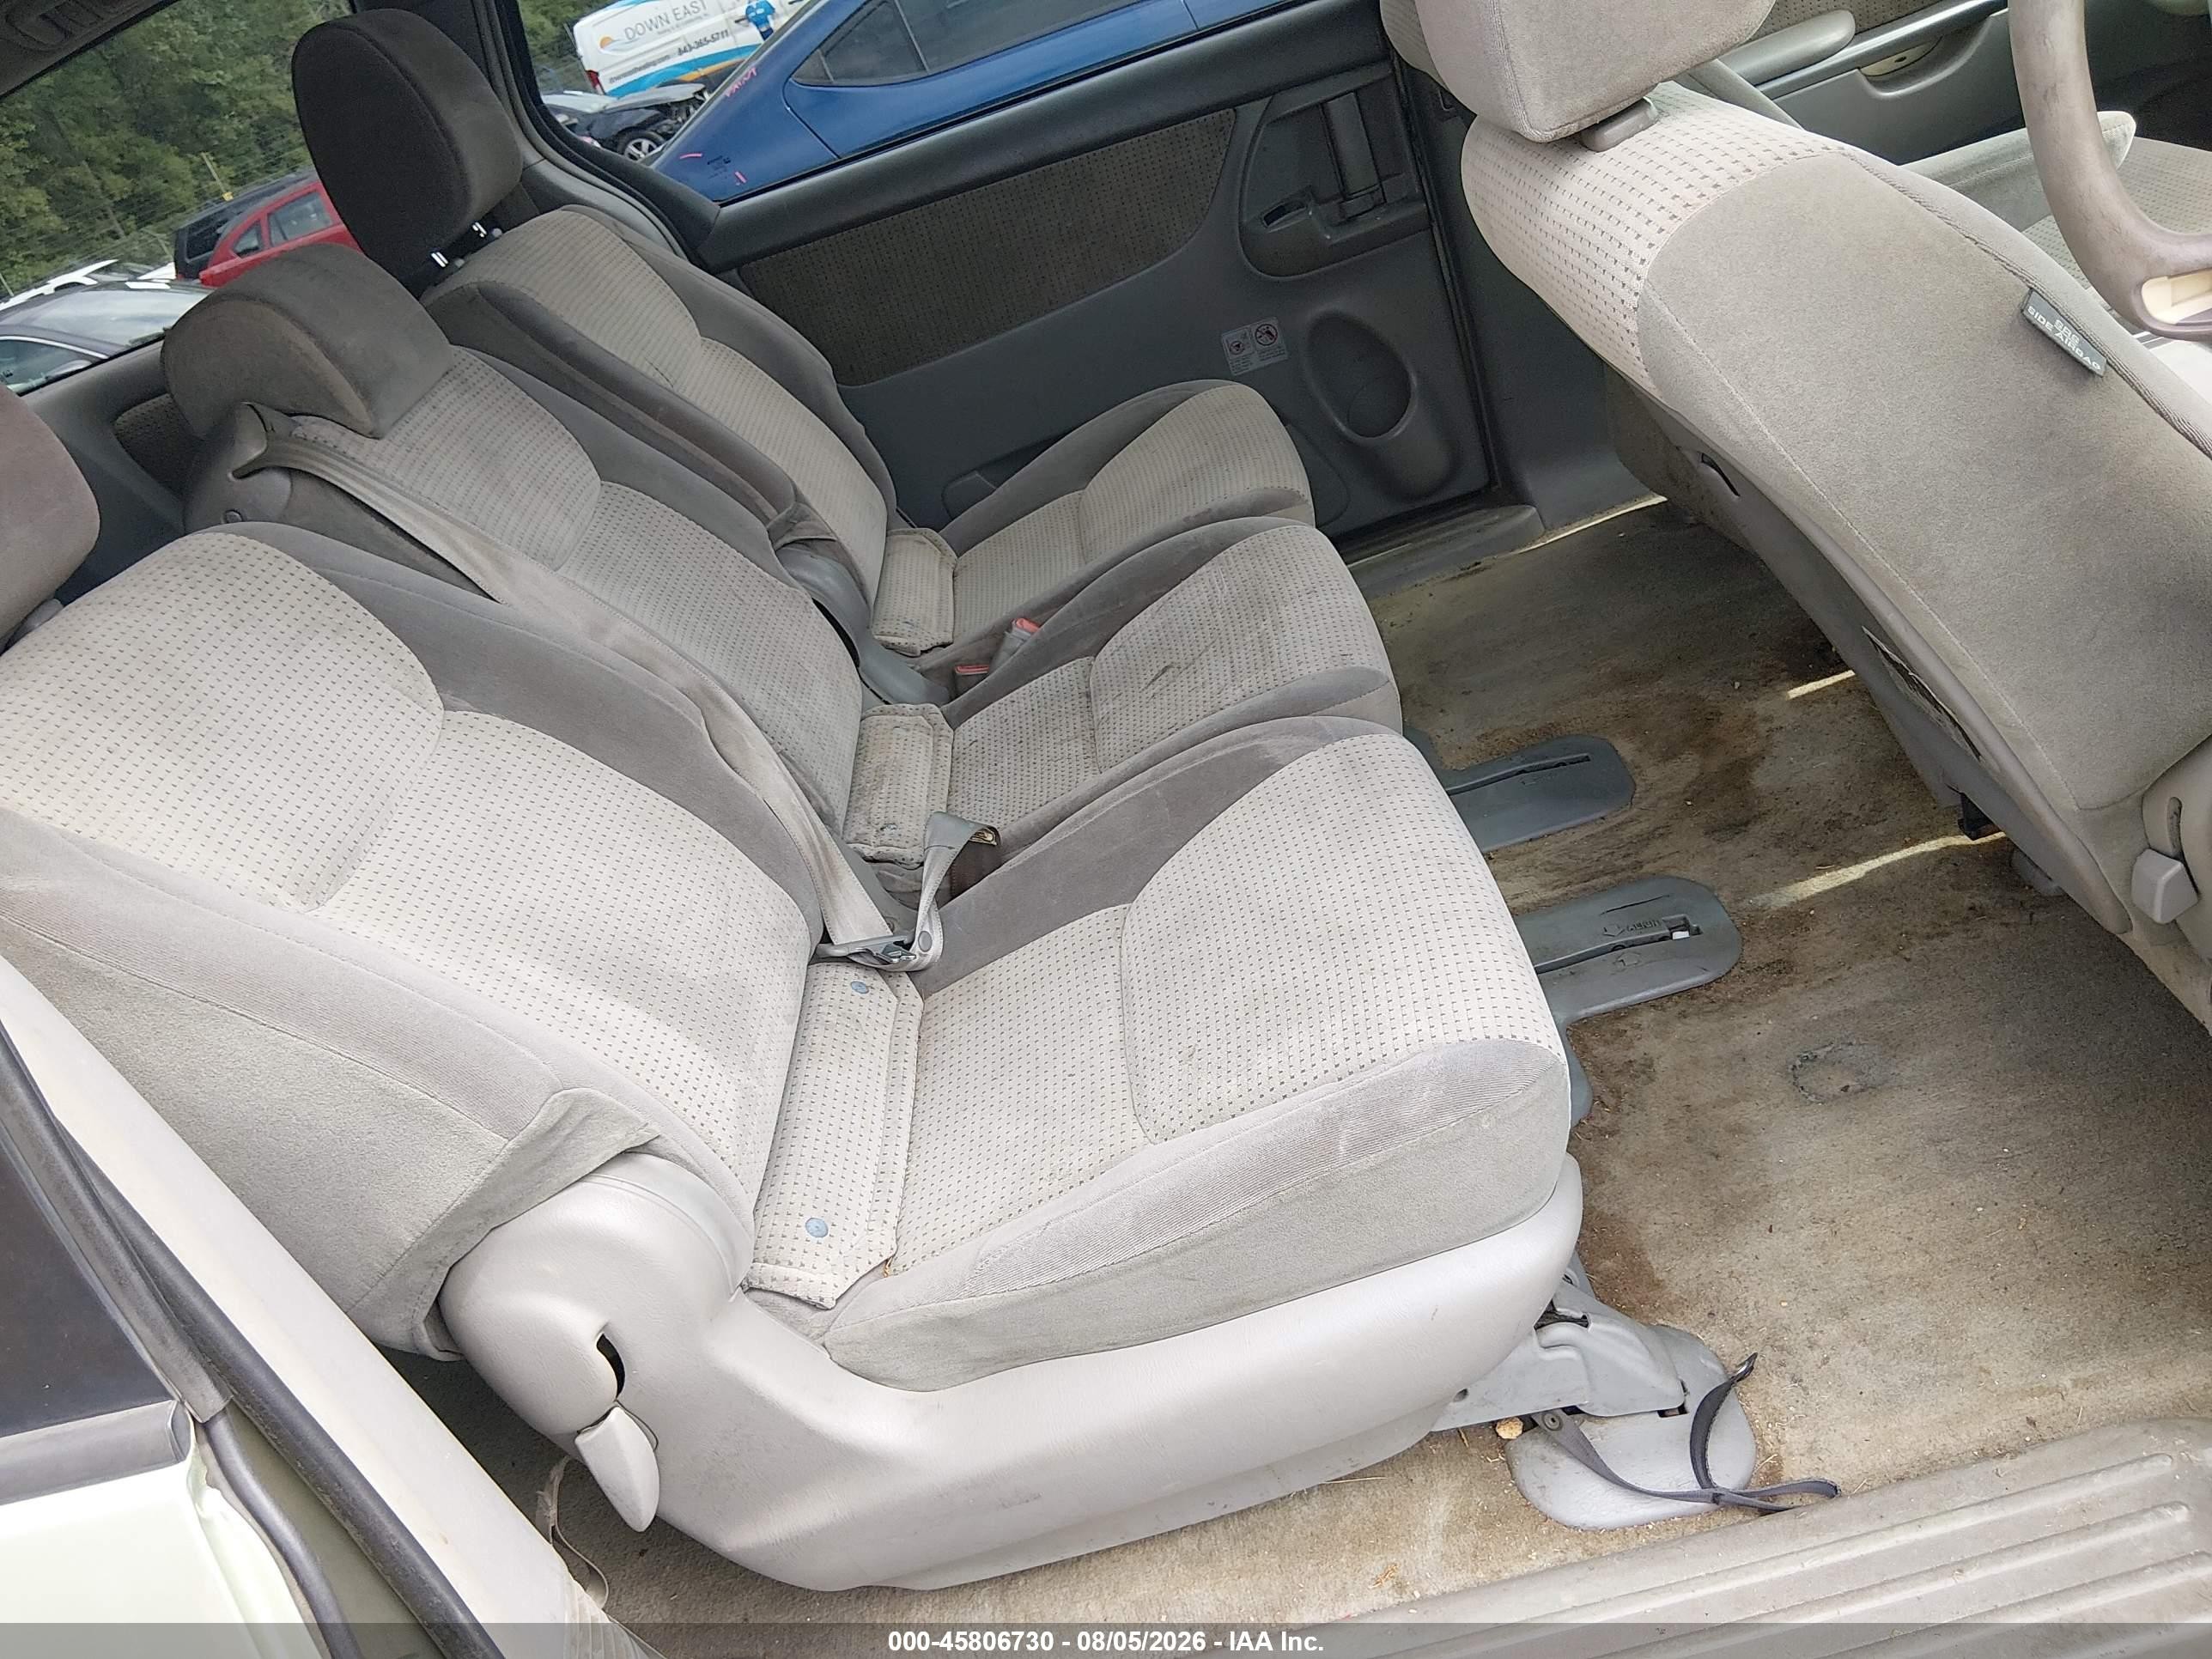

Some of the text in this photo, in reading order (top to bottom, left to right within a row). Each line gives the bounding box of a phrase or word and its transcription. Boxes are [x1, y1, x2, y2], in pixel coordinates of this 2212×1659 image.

[624, 12, 670, 40] DOWN
[672, 0, 708, 21] EAST
[2027, 306, 2101, 370] SIDE AIRBAG
[2054, 319, 2080, 344] SRS
